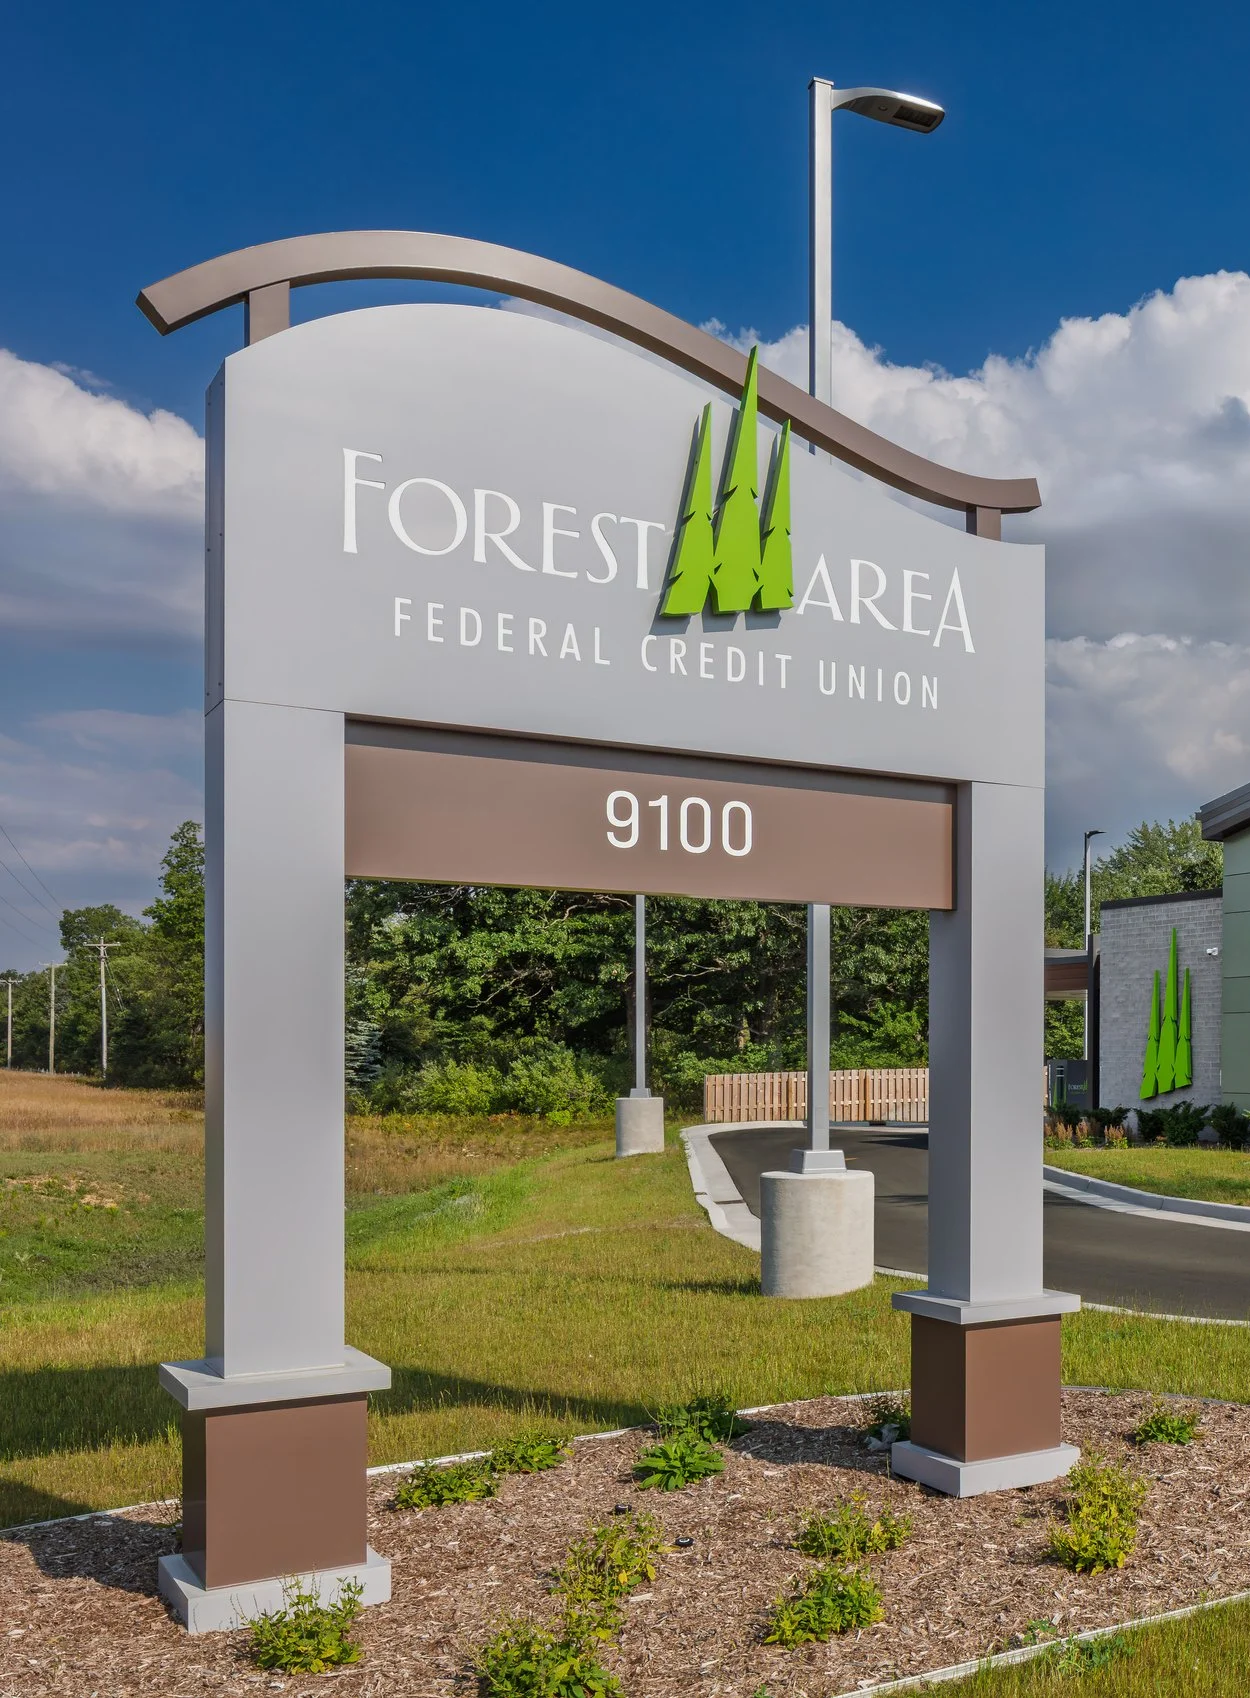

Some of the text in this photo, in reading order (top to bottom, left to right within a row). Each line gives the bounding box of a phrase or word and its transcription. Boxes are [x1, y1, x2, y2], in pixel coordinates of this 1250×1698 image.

[342, 447, 976, 654] FOREST AREA
[394, 597, 938, 710] FEDERAL CREDIT UNION
[606, 790, 752, 857] 9100
